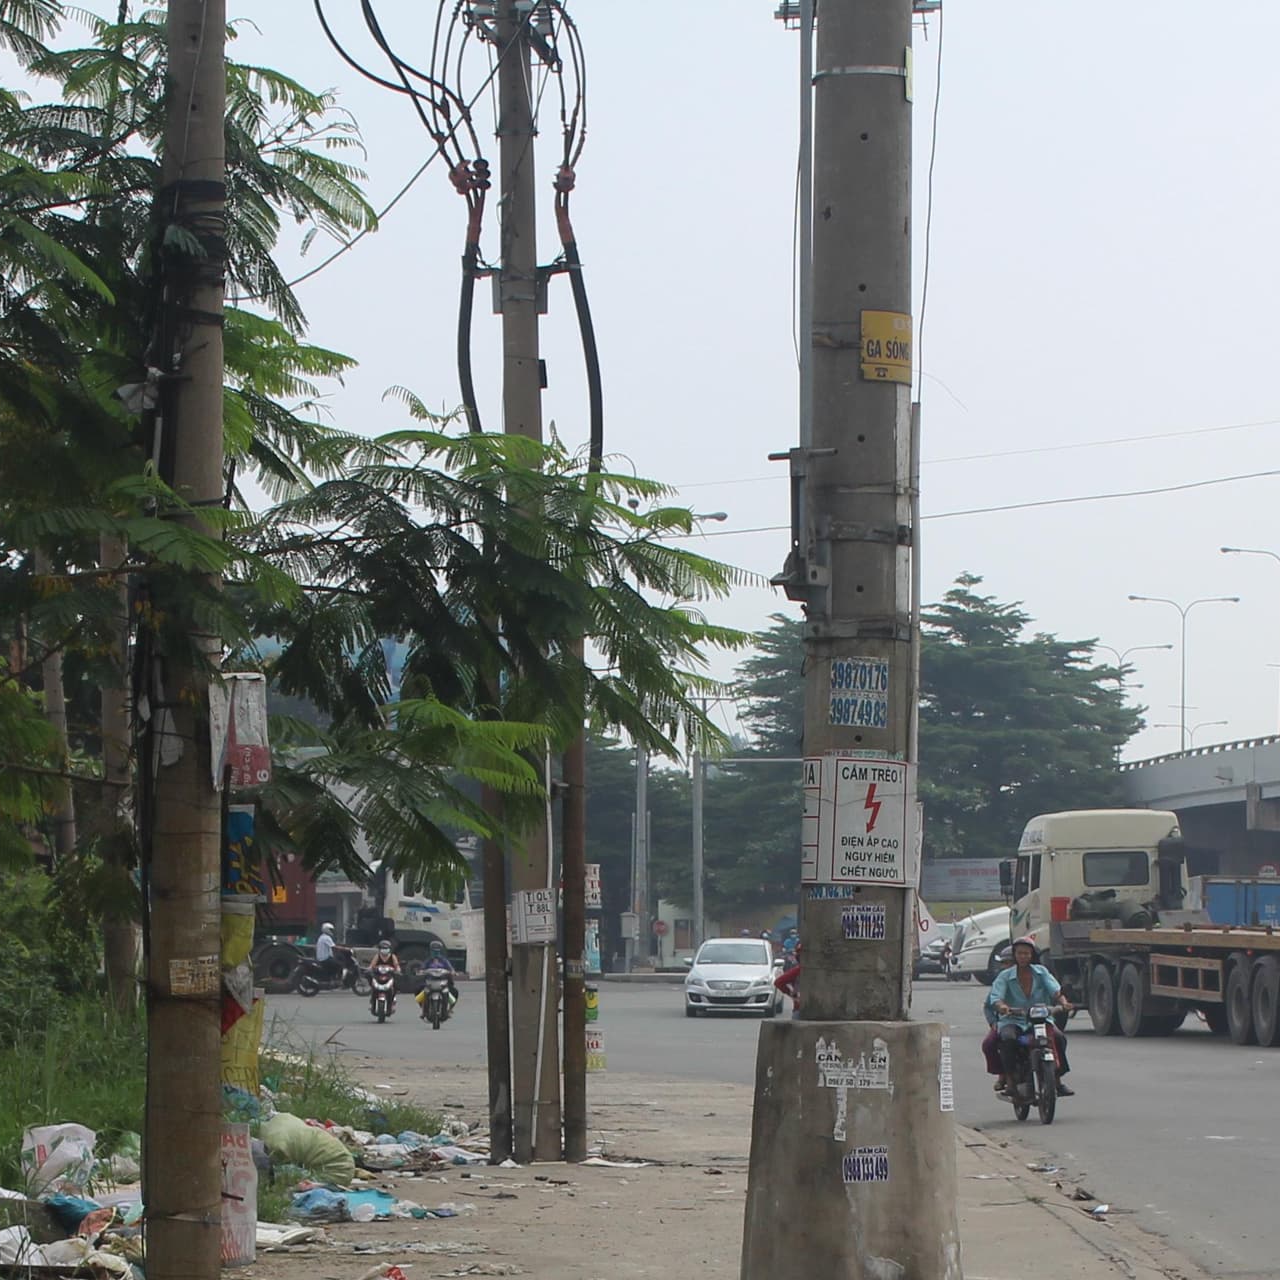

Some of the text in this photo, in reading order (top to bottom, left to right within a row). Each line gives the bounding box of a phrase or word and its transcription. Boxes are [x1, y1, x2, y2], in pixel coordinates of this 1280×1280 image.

[866, 339, 882, 358] GA
[841, 836, 899, 849] ĐIỆN ÁP CAO
[844, 851, 873, 862] NGUY
